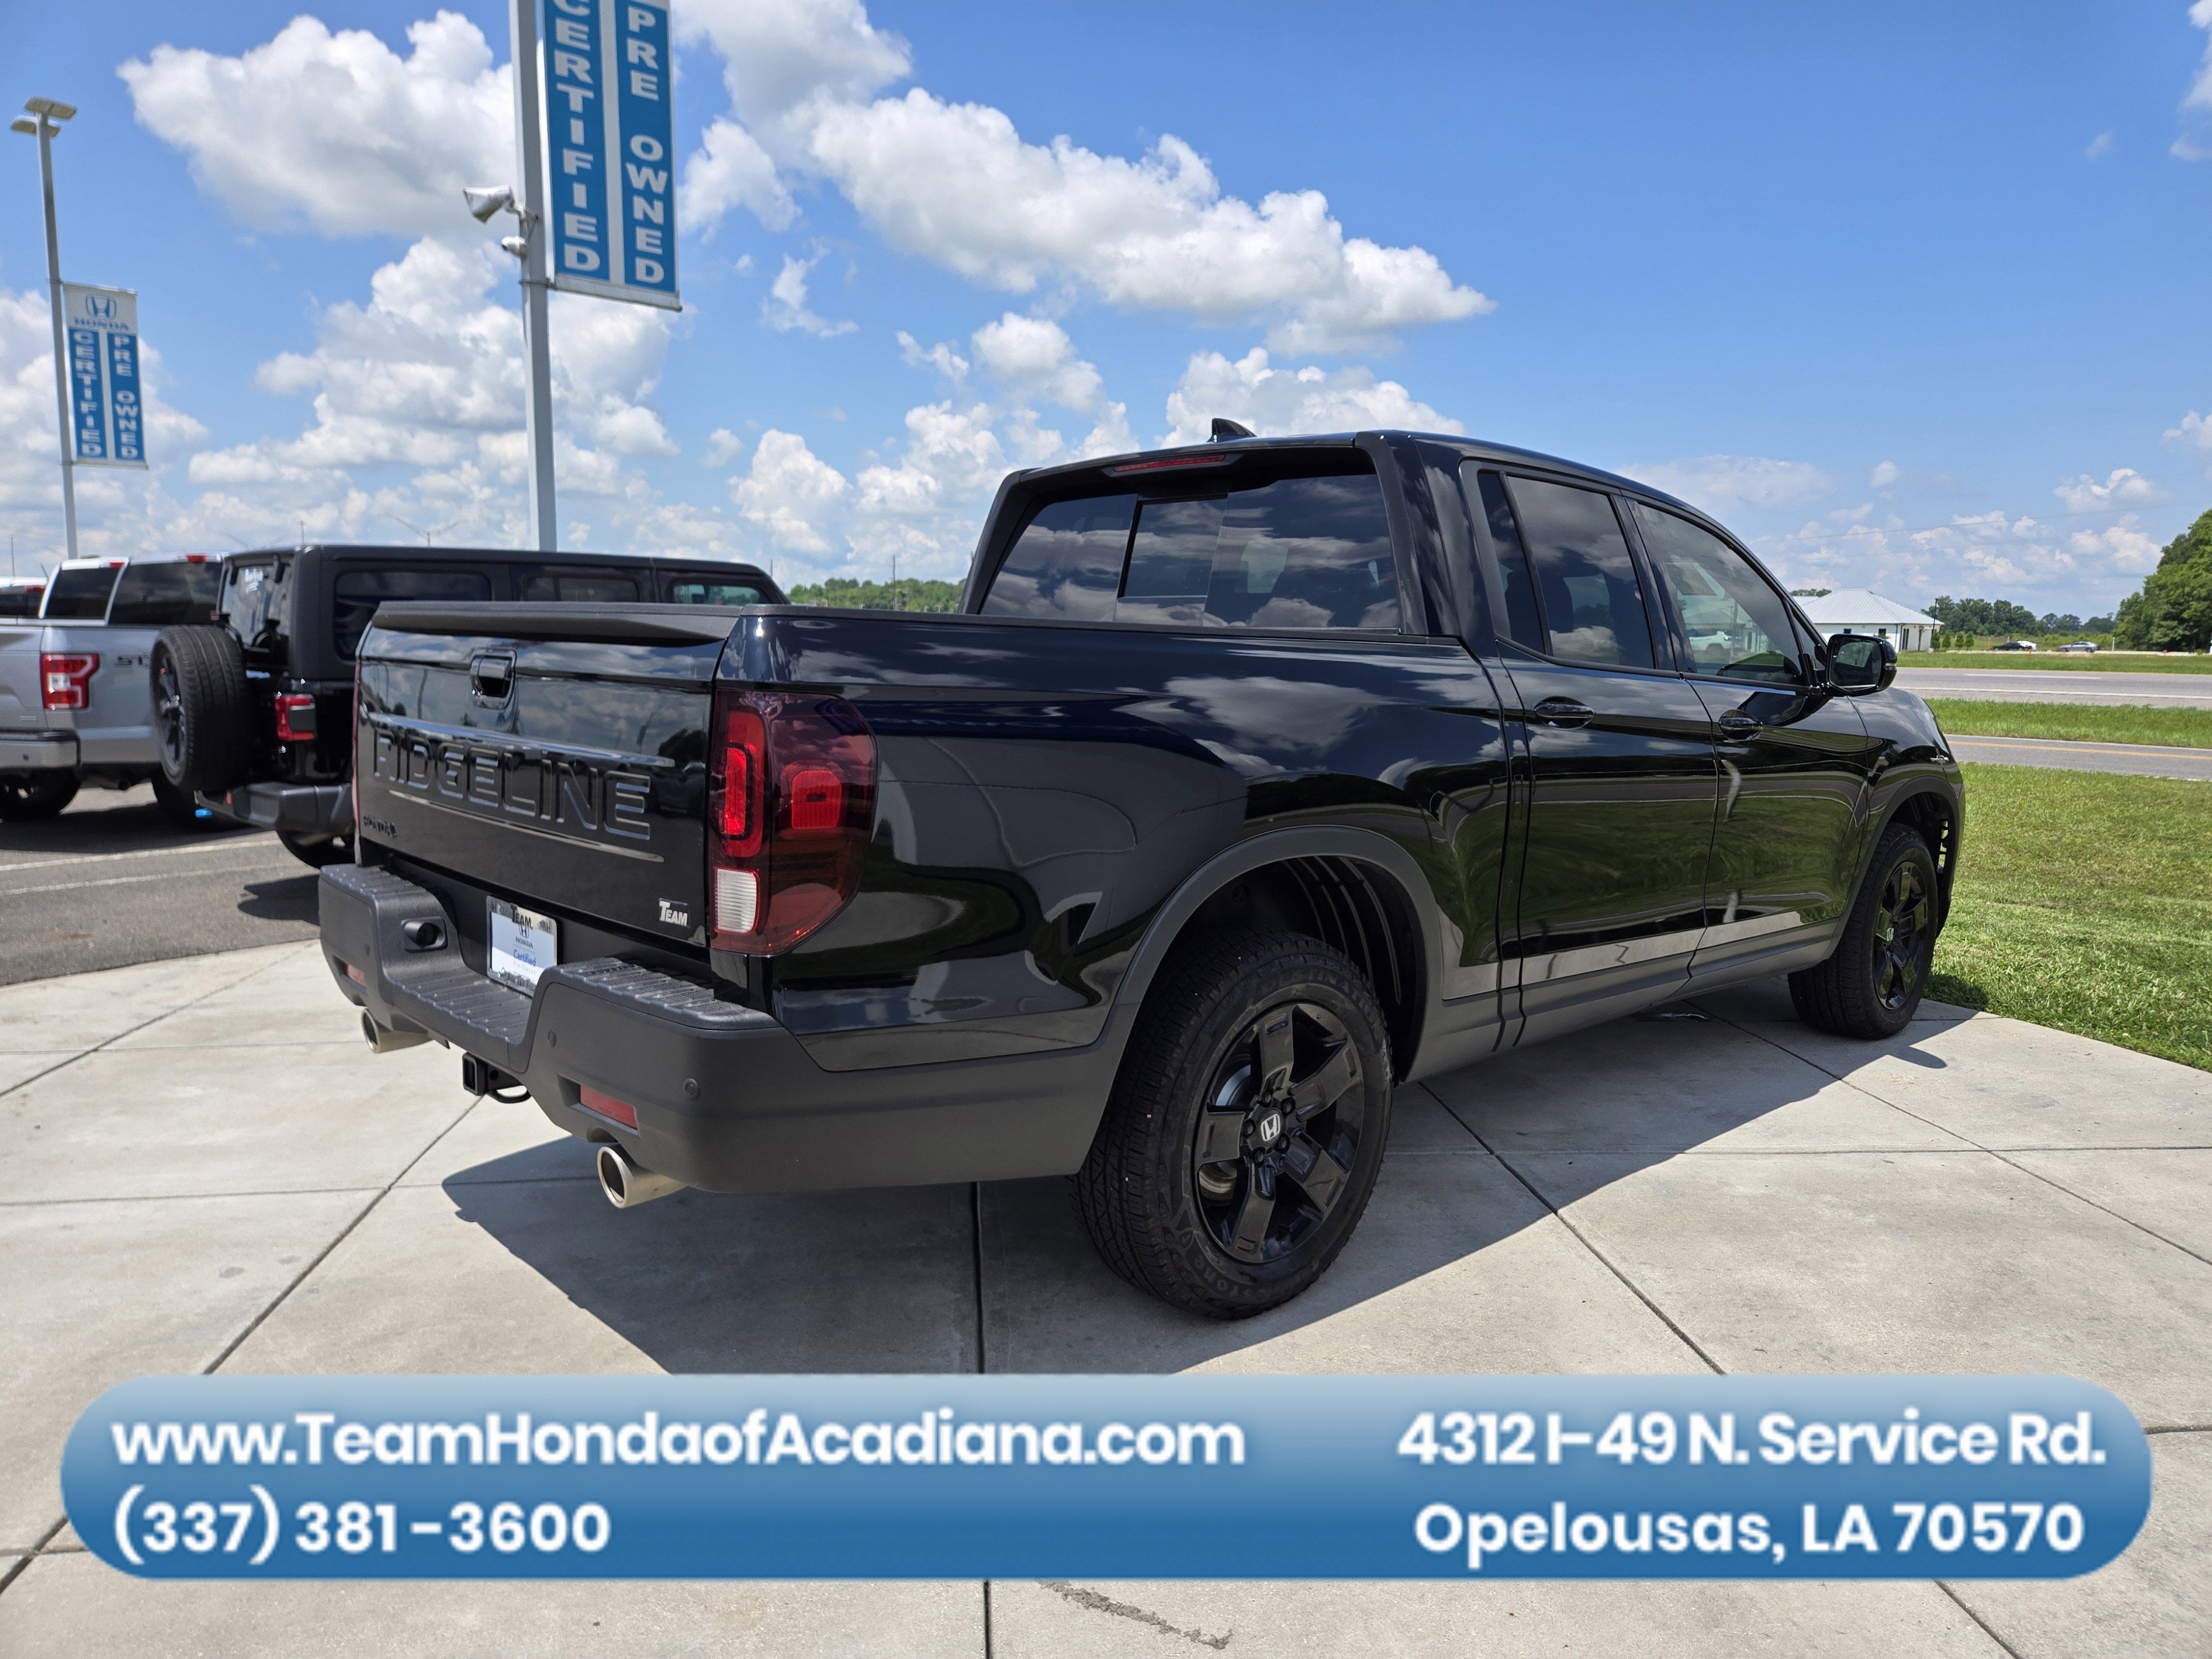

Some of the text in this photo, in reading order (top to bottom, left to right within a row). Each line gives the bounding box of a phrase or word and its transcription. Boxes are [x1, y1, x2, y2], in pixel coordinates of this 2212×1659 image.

[554, 0, 600, 271] CERTIFIED
[625, 6, 667, 283] PRE OWNED
[74, 317, 129, 330] HONDA
[74, 331, 102, 456] CERTIFIED
[114, 335, 138, 458] PRE OWNED
[373, 727, 650, 840] RIDGELINE
[513, 950, 536, 967] Certified
[515, 937, 533, 948] HONDA
